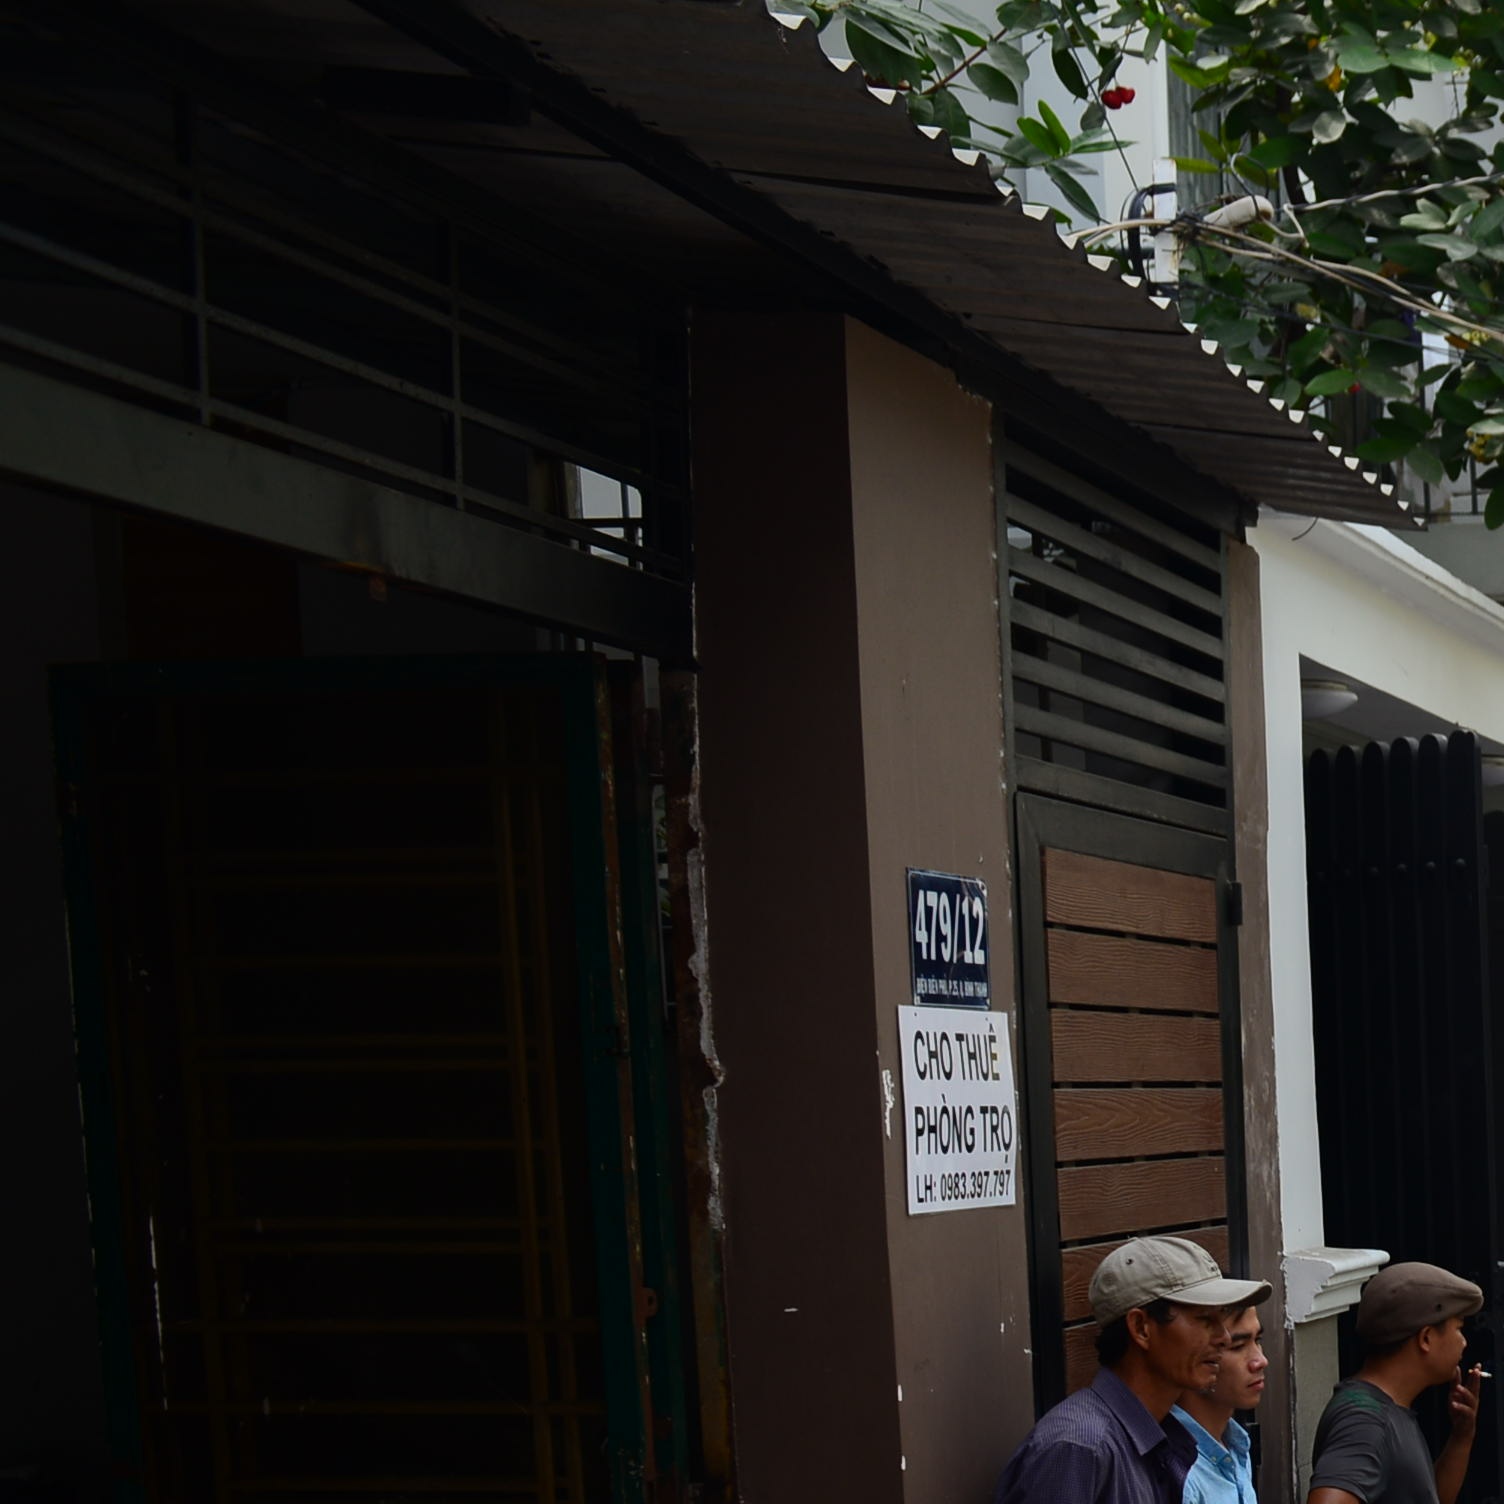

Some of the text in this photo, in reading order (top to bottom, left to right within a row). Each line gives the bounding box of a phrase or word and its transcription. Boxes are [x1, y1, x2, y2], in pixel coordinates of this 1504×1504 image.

[915, 888, 985, 966] 479/12
[914, 1023, 1000, 1081] CHO THUÊ
[914, 1094, 1013, 1163] PHÒNG TRỌ
[916, 1169, 1012, 1204] LH: 0983.397.797
